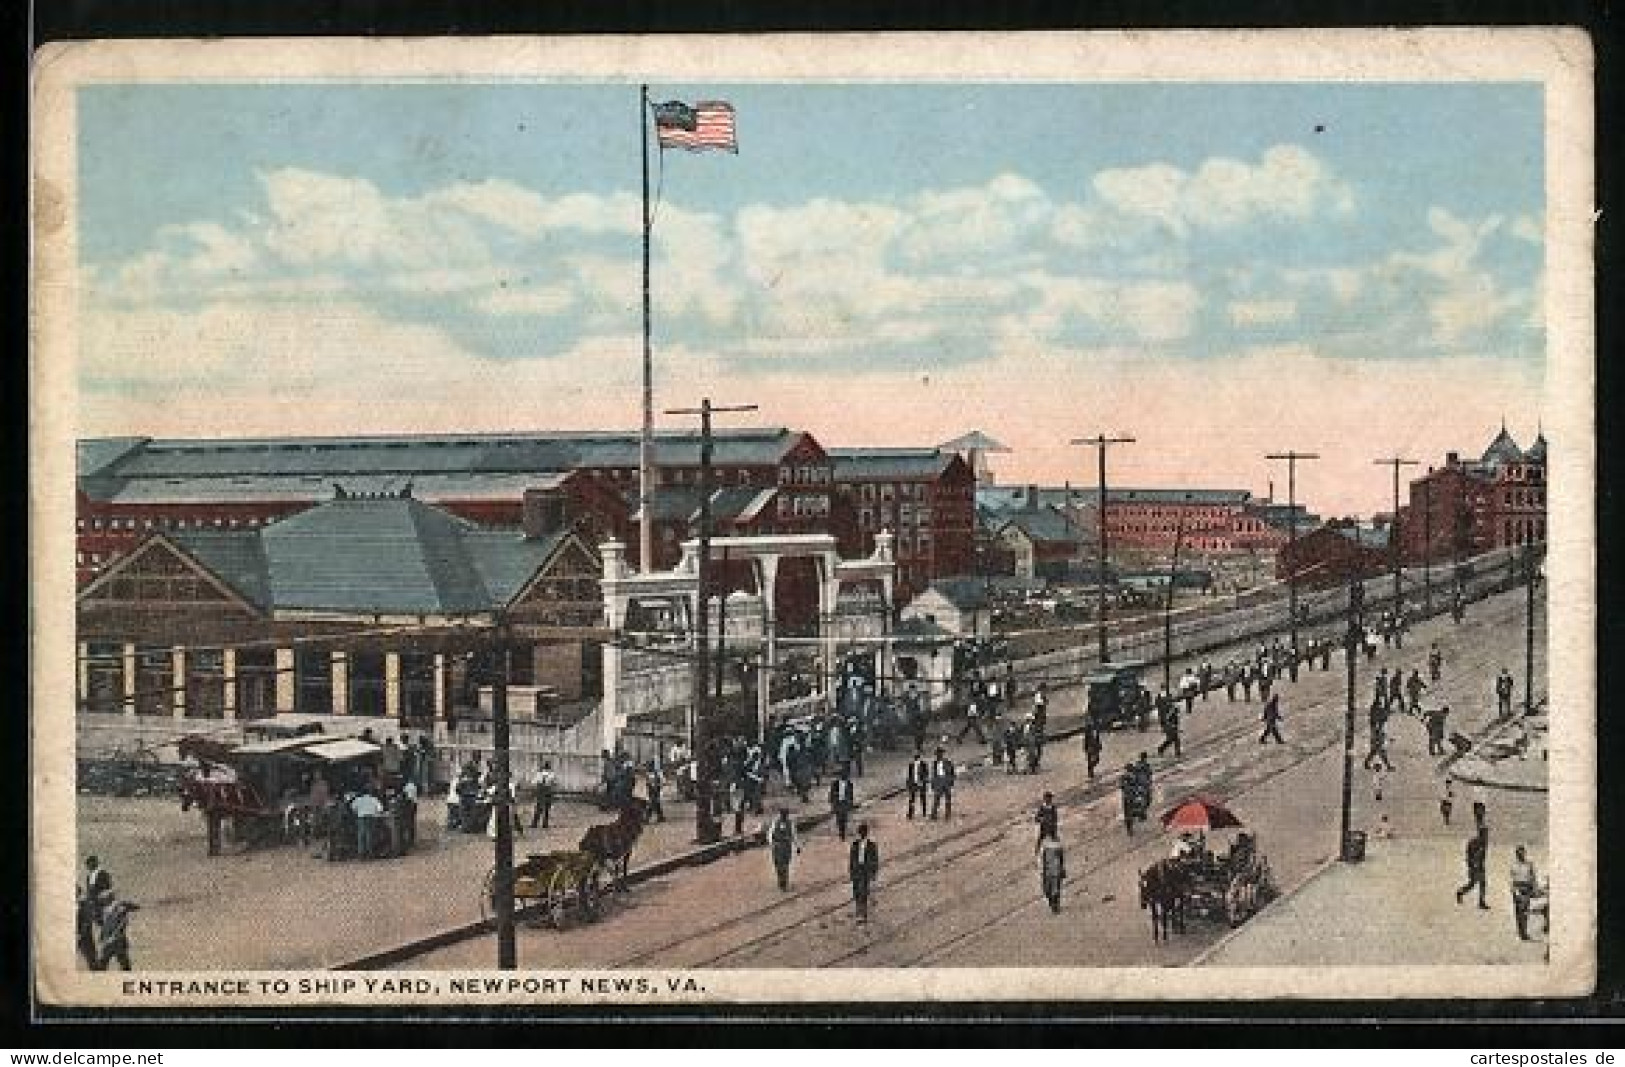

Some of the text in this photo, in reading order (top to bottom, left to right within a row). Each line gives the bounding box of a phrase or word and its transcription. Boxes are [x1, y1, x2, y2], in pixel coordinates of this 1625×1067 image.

[122, 979, 250, 994] ENTRANCE
[257, 979, 289, 994] TO
[299, 979, 356, 994] SHIP
[365, 979, 440, 996] YARD,
[450, 978, 571, 994] NEWPORT
[667, 978, 706, 994] VA.
